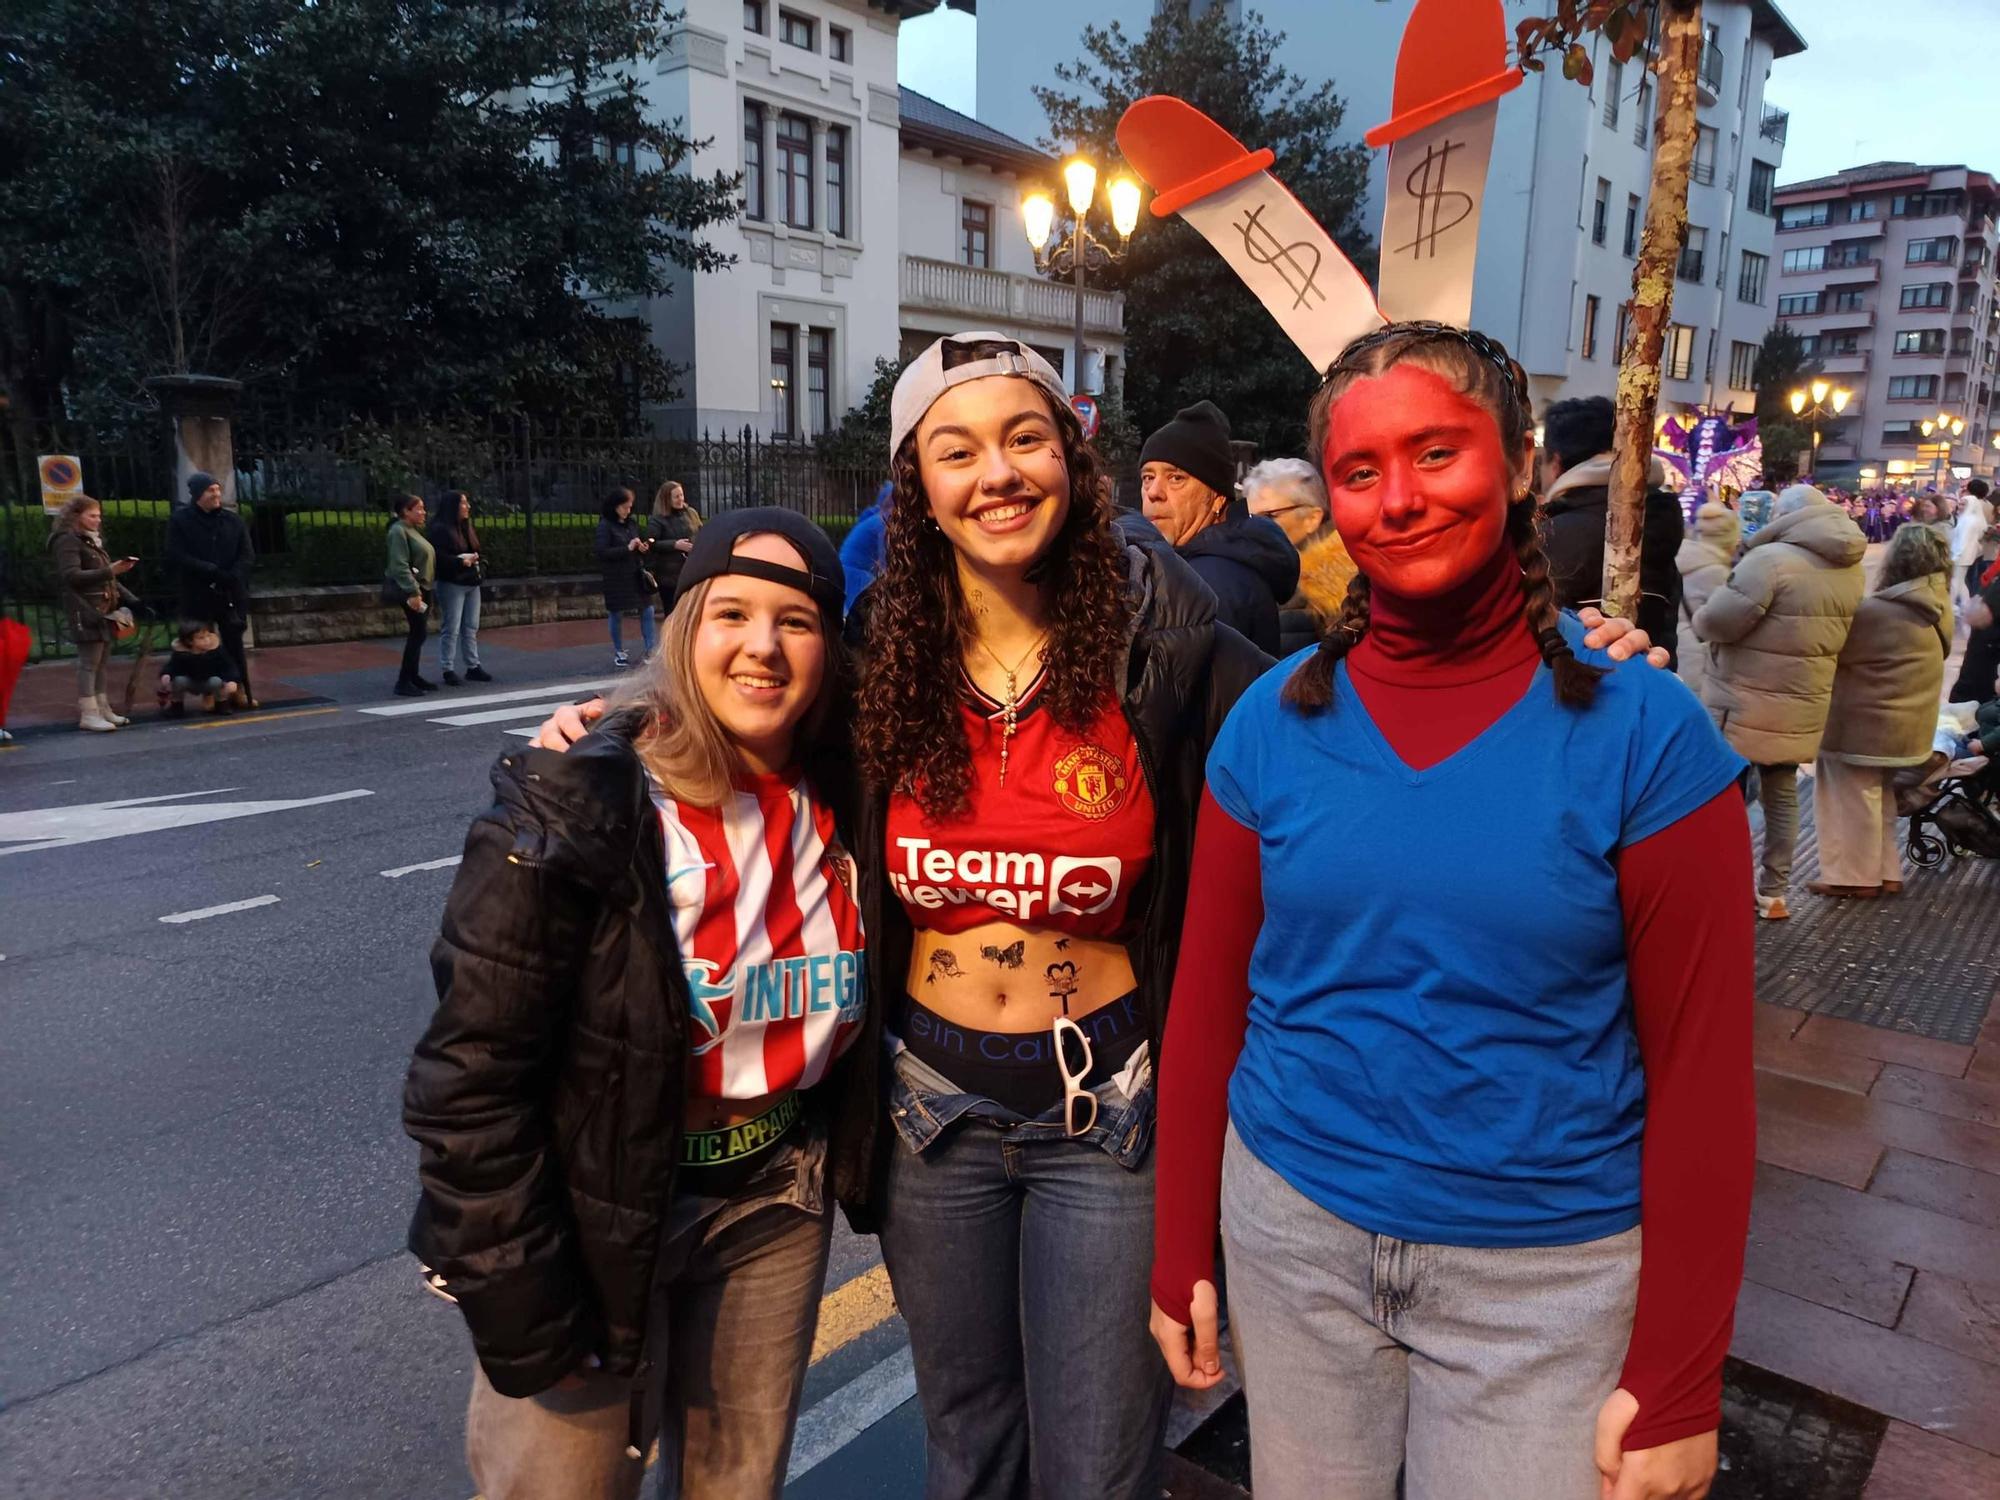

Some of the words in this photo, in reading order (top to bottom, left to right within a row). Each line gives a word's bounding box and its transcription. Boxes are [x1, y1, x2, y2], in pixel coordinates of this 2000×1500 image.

[1393, 140, 1473, 259] $
[1233, 204, 1327, 310] $
[1061, 751, 1119, 775] MANCHESTER
[1074, 800, 1115, 813] UNITED
[896, 837, 1045, 886] Team
